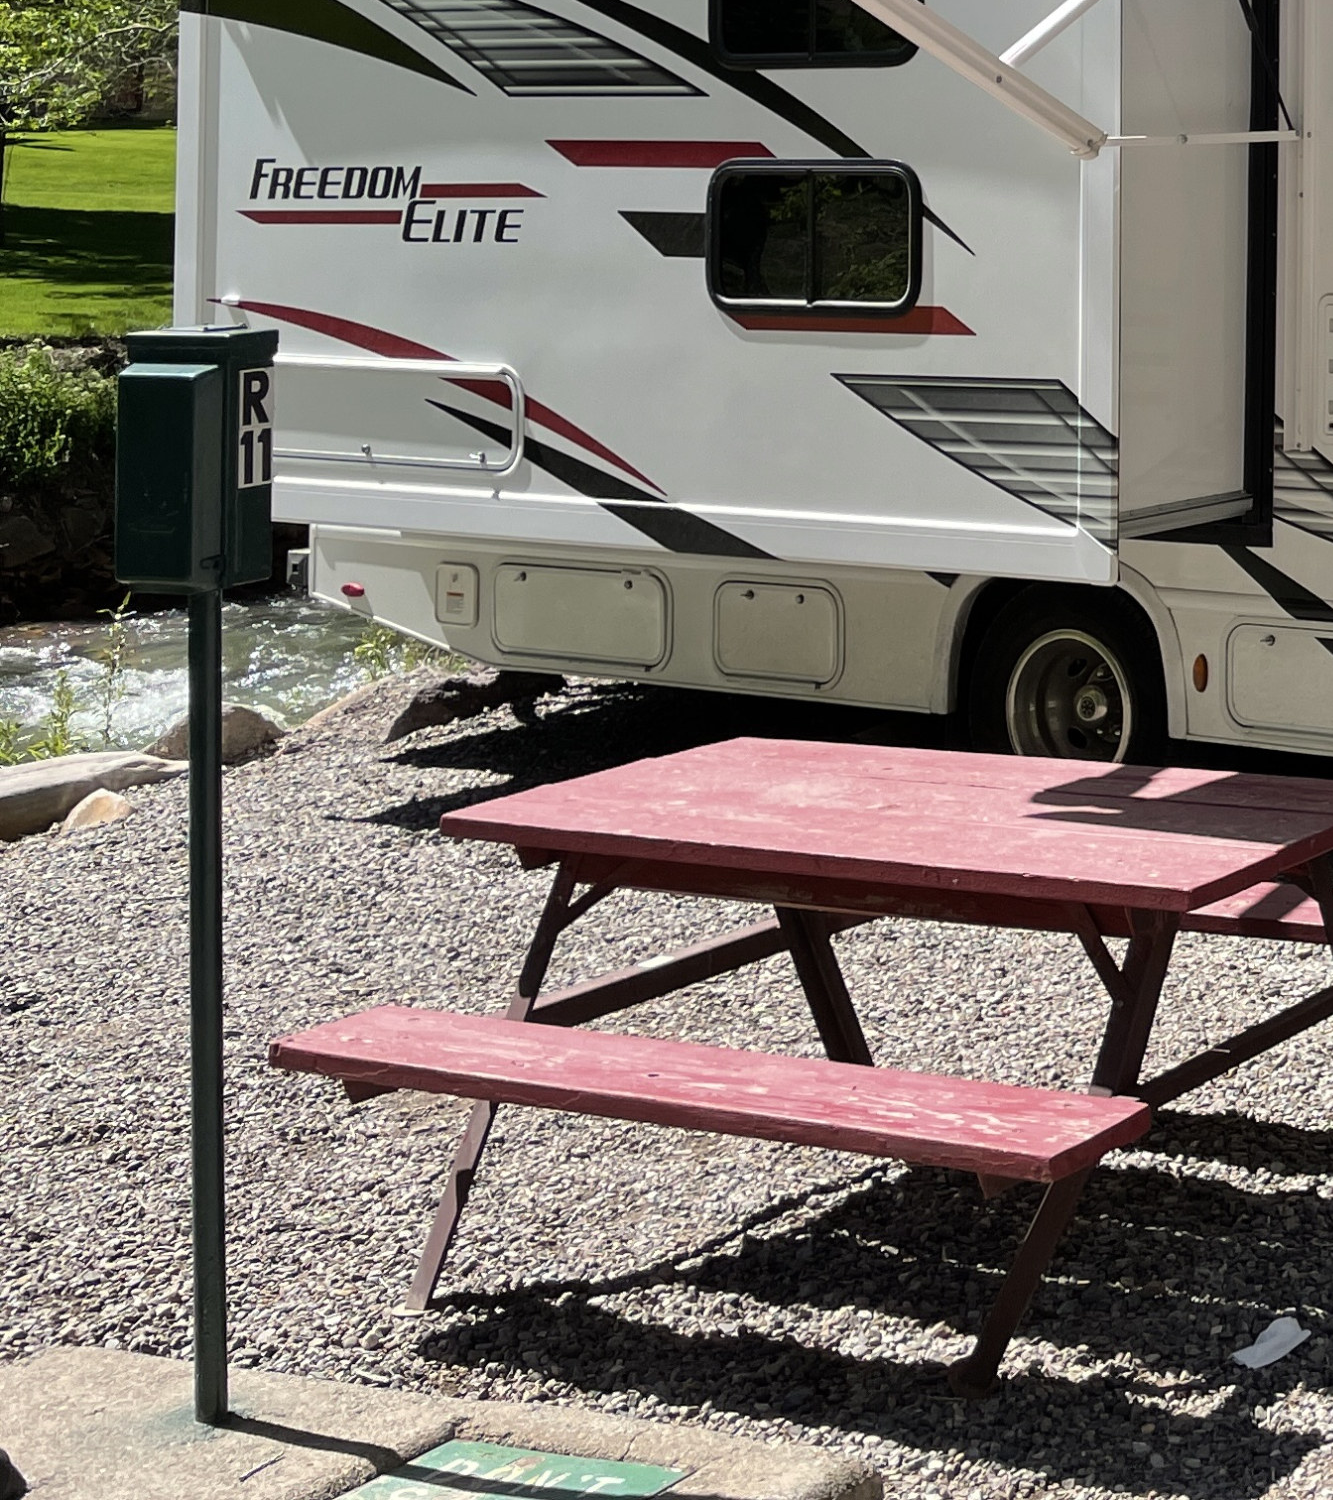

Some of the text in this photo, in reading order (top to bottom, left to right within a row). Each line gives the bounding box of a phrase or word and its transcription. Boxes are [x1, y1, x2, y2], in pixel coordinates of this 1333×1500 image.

[249, 157, 423, 200] FREEDOM
[401, 199, 525, 243] ELITE
[242, 370, 270, 426] R
[240, 427, 271, 485] 11
[421, 1457, 626, 1498] DON'T
